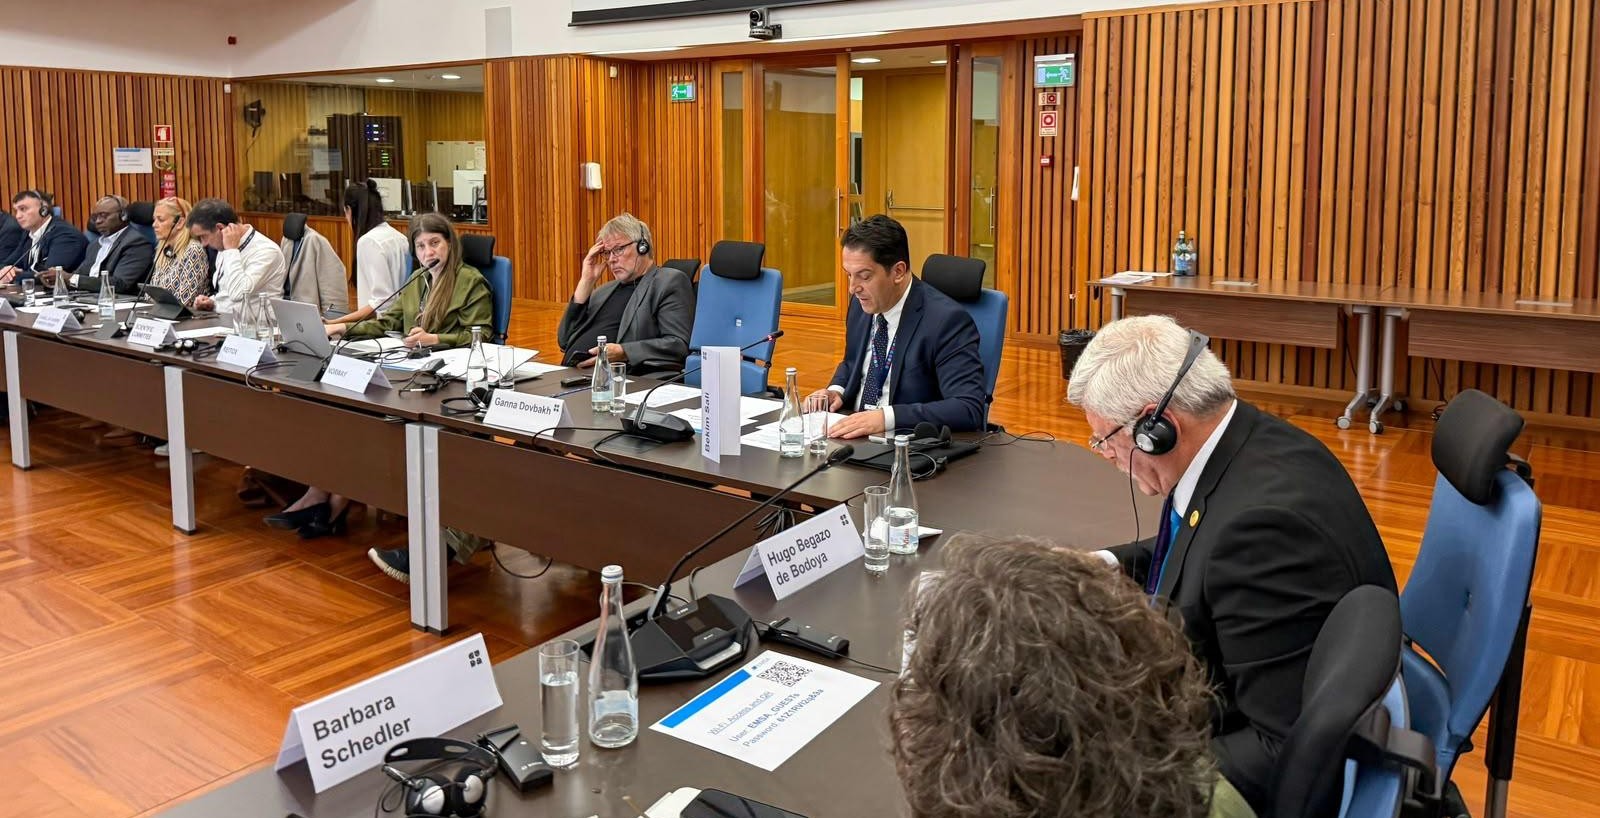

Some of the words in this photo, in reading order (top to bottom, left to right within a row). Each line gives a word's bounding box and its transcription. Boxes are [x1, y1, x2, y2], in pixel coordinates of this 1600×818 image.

[494, 397, 518, 409] Ganna
[519, 401, 552, 415] Dovbakh
[767, 546, 796, 566] Hugo
[796, 529, 831, 554] Begazo
[776, 572, 790, 586] de
[791, 553, 828, 579] Bodoya
[312, 696, 396, 741] Barbara
[321, 717, 411, 769] Schedler
